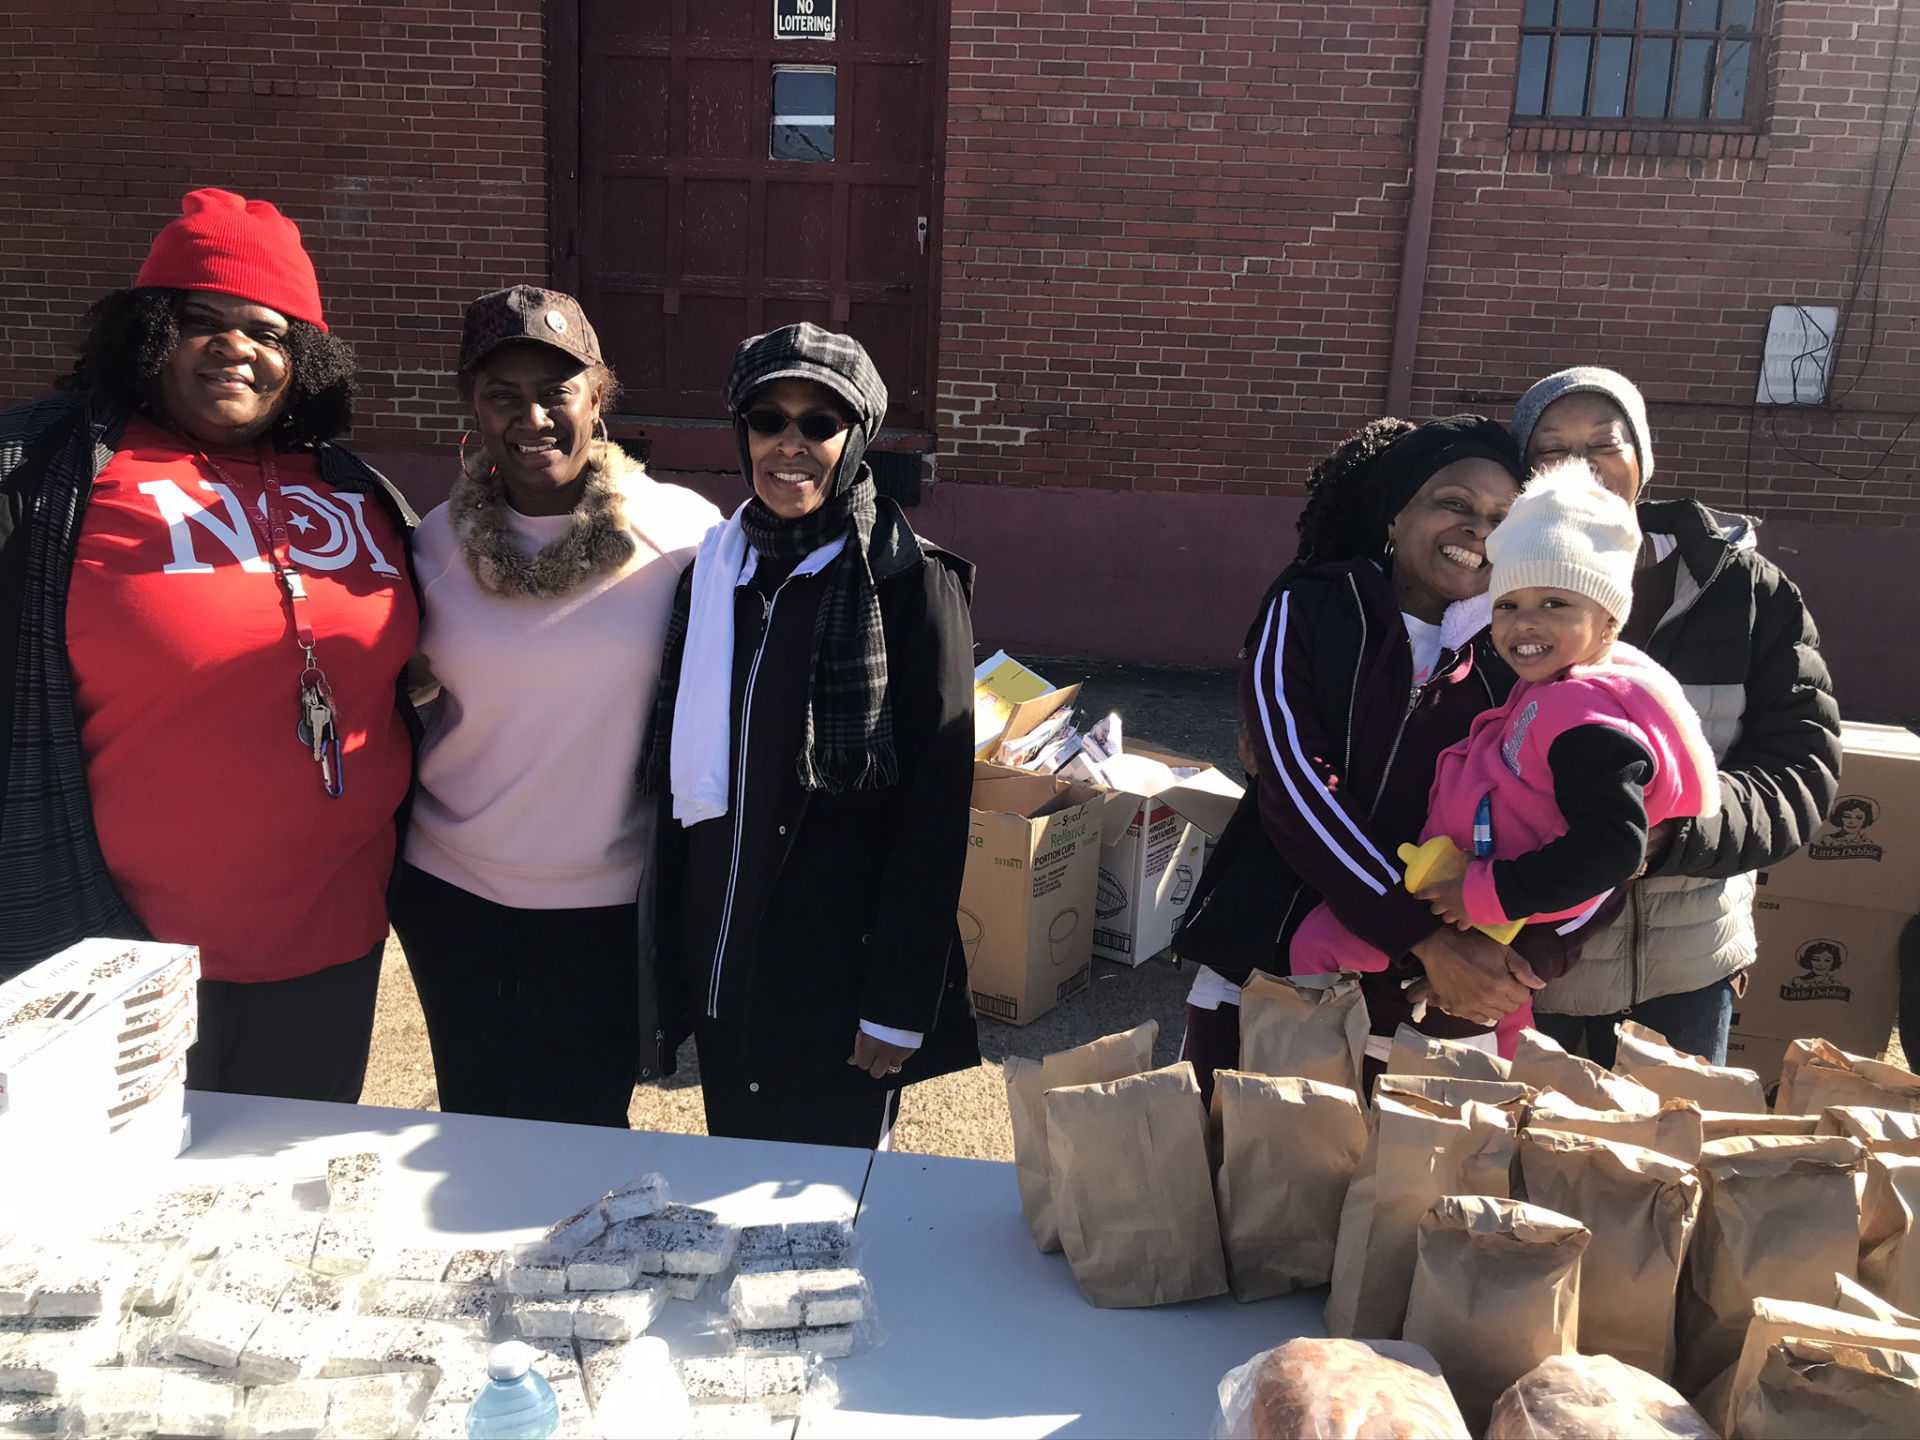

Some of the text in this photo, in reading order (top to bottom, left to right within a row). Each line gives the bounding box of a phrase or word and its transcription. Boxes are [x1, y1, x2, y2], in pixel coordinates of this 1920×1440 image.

[797, 0, 814, 14] NO
[779, 15, 831, 32] LOITERING
[138, 479, 400, 577] NOI
[1147, 825, 1177, 844] CONTAINERS
[1148, 820, 1167, 835] HINGED
[1050, 824, 1087, 849] Reliance
[1034, 847, 1061, 866] PORTION
[1061, 842, 1076, 857] CUPS
[1812, 846, 1879, 857] Little Debbie
[1783, 988, 1848, 999] Little Debbie
